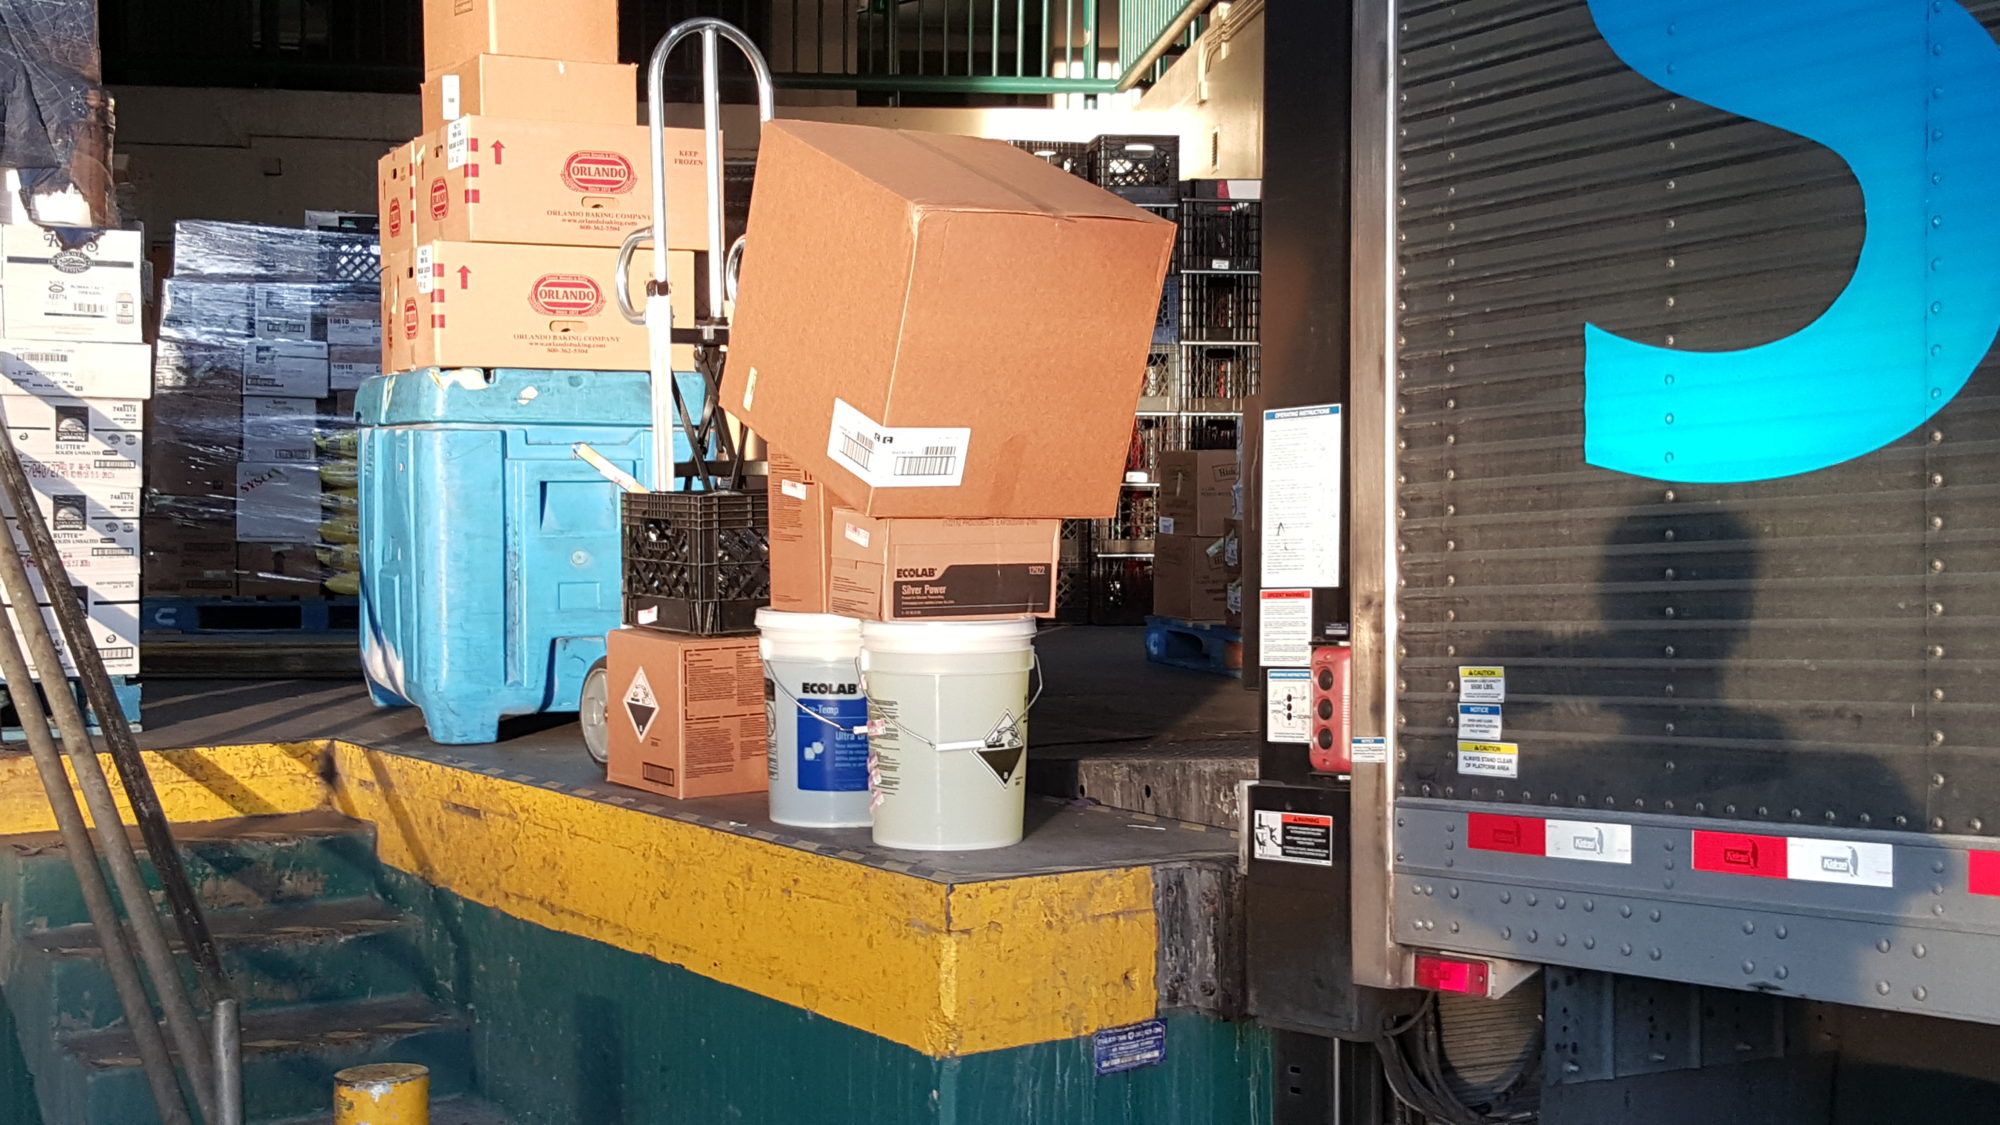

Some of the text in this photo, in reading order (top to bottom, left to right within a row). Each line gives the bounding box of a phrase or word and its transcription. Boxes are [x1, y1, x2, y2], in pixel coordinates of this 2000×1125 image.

[674, 158, 703, 166] FROZEN
[571, 165, 626, 179] ORLANDO
[546, 209, 584, 217] ORLANDO
[585, 211, 614, 219] BAKING
[539, 288, 595, 301] ORLANDO
[513, 333, 621, 343] ORLANDO BAKING COMPANY
[896, 567, 937, 578] ECOLAB
[901, 584, 947, 596] Silver Power
[801, 682, 857, 695] ECOLAB
[1470, 706, 1489, 714] NOTICE
[836, 730, 855, 741] Ultra
